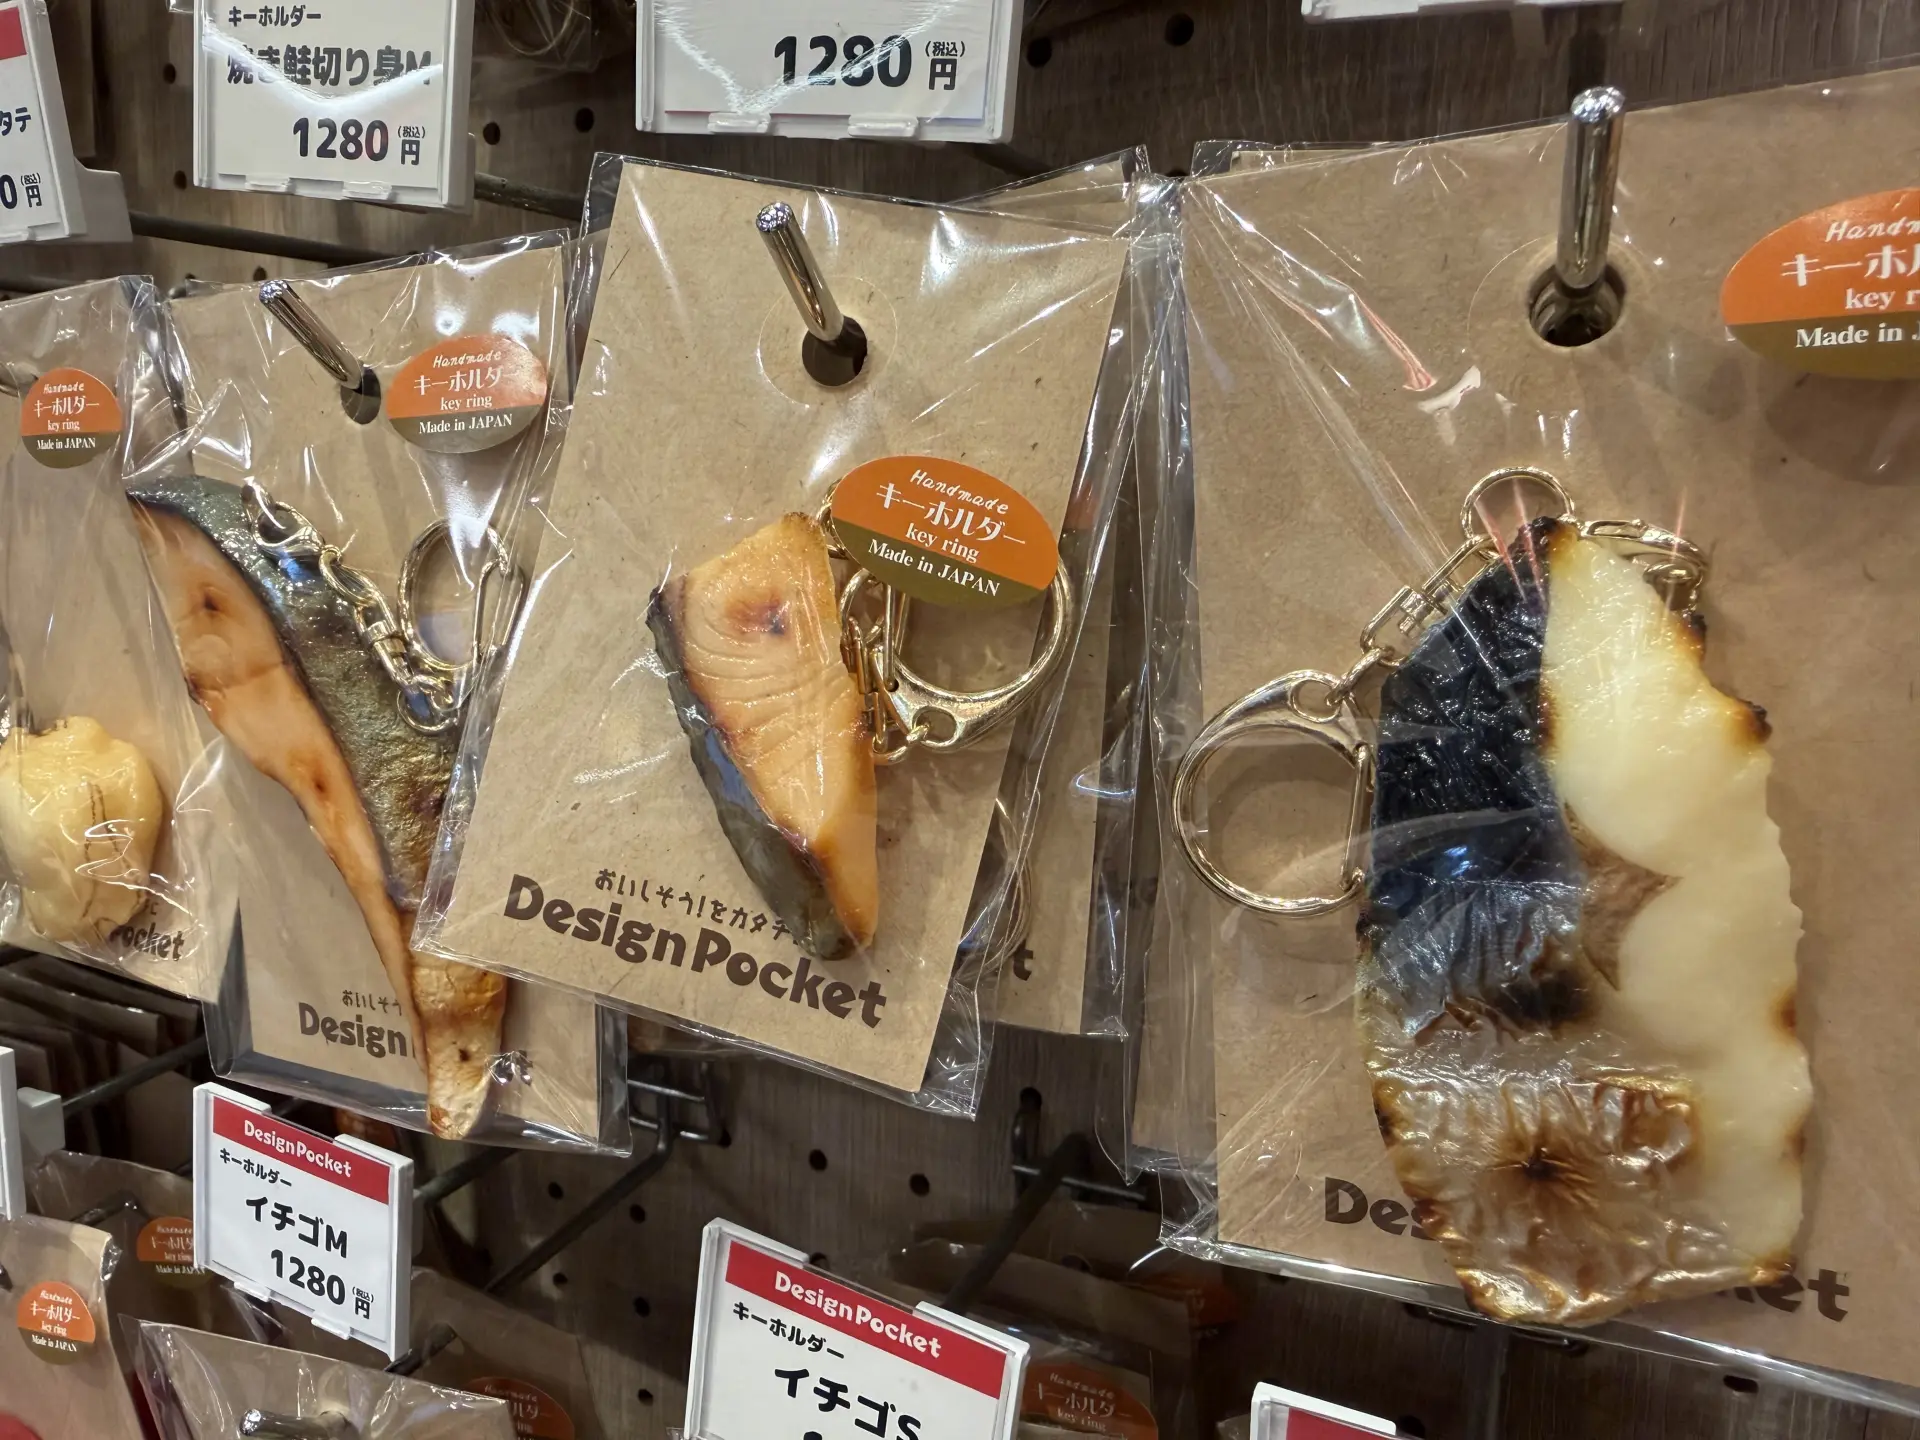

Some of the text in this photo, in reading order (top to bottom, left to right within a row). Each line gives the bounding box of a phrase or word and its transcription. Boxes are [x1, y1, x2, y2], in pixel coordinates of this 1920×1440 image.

[228, 5, 322, 28] キーホルダー
[773, 34, 912, 88] 1280
[928, 58, 958, 90] 円
[293, 117, 389, 161] 1280
[400, 139, 421, 165] 円
[25, 184, 42, 208] 円
[1845, 288, 1896, 310] key
[1796, 324, 1869, 348] Made
[1878, 322, 1903, 343] in
[413, 365, 520, 396] キーホルダー
[433, 350, 502, 369] Handmade
[33, 395, 100, 418] キーホルダー
[418, 413, 513, 434] Made in JAPAN
[439, 394, 493, 411] key ring
[37, 437, 96, 450] Made in JAPAN
[62, 418, 80, 432] ring
[876, 482, 1026, 545] キーホルダー
[909, 469, 1009, 515] Handmade
[905, 522, 980, 564] key ring
[868, 538, 1001, 597] Made in JAPAN
[595, 868, 798, 945] おいしそう!をカタチ
[112, 922, 185, 961] ocket
[503, 873, 888, 1029] DesignPocket
[298, 1002, 416, 1059] Design
[219, 1148, 293, 1187] キーホルダー
[244, 1119, 352, 1177] DesignPocket
[246, 1196, 348, 1259] イチゴM
[271, 1249, 346, 1305] 1280
[354, 1297, 371, 1320] 円
[733, 1301, 845, 1360] キーホルダー
[775, 1270, 942, 1358] DesignPocket
[774, 1367, 921, 1440] イチゴS
